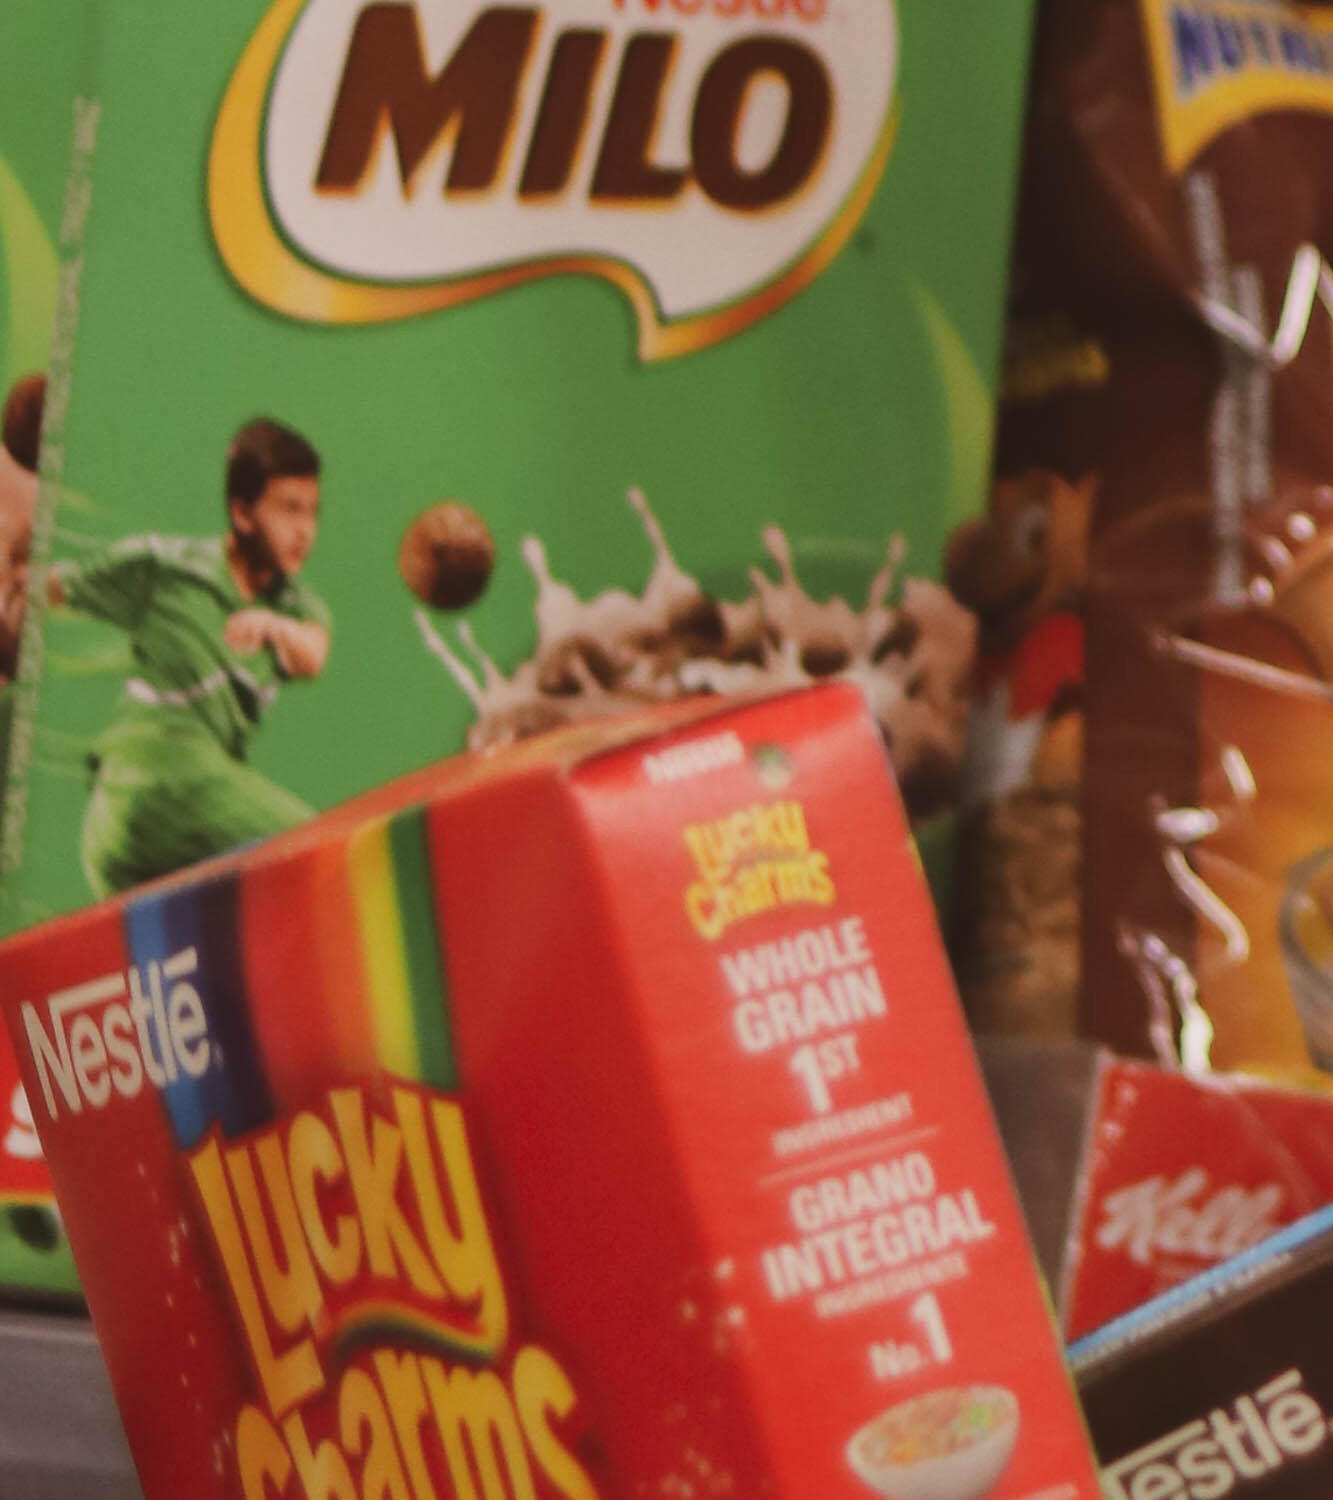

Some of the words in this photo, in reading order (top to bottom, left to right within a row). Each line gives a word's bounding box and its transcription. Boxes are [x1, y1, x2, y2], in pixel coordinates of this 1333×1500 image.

[682, 799, 810, 883] Lucky
[684, 849, 837, 942] Charms
[720, 914, 873, 996] WHOLE
[21, 946, 211, 1120] Nestlé
[732, 964, 887, 1054] GRAIN
[788, 1031, 860, 1114] 1ST
[790, 1151, 936, 1232] GRANO
[190, 1087, 508, 1413] Lucky
[761, 1187, 996, 1301] INTEGRAL
